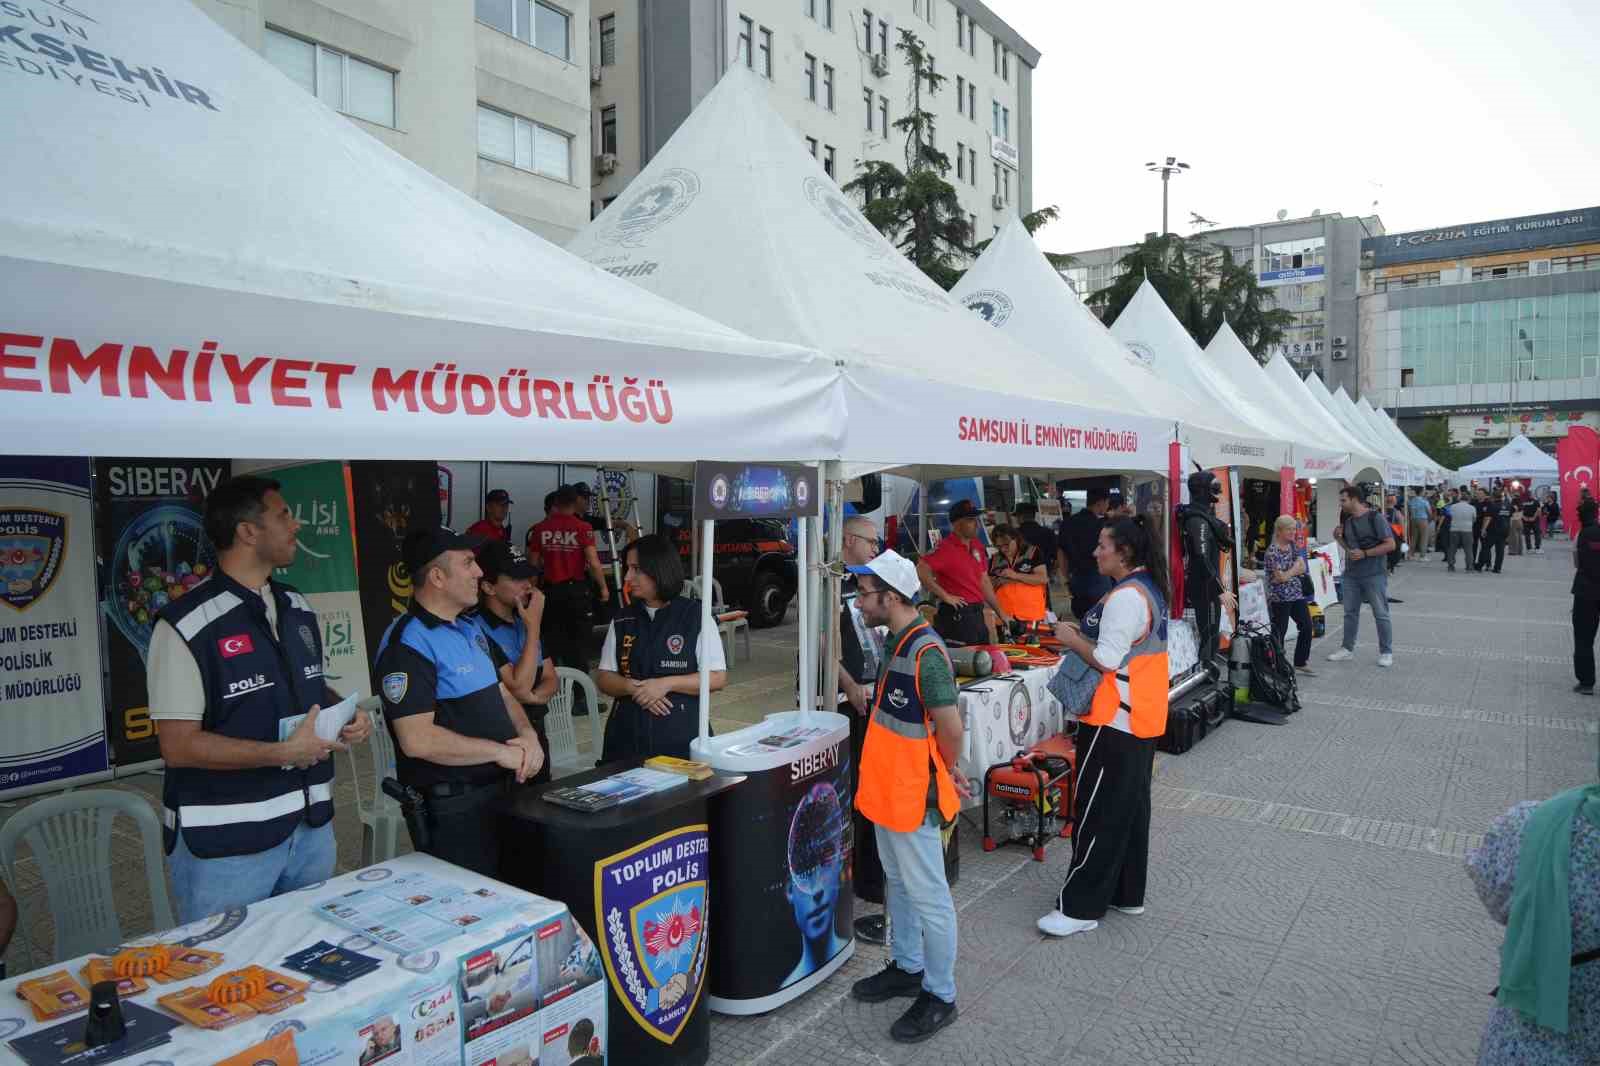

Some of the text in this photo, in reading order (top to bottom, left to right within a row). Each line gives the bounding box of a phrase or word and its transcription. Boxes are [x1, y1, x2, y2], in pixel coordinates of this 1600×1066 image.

[1515, 214, 1585, 232] KURUMLARI
[0, 332, 674, 424] EMNİYET MÜDÜRLÜĞÜ
[957, 415, 1139, 453] SAMSUN İL EMNİYET MÜDÜRLÜĞÜ
[316, 525, 341, 536] ANNE
[541, 530, 579, 545] PAK
[20, 616, 78, 641] DESTEKLİ
[329, 645, 355, 657] ANNE
[5, 673, 82, 701] MÜDÜRLÜĞÜ
[228, 673, 266, 694] POLİS
[611, 846, 673, 886] TOPLUM
[652, 861, 700, 894] POLİS
